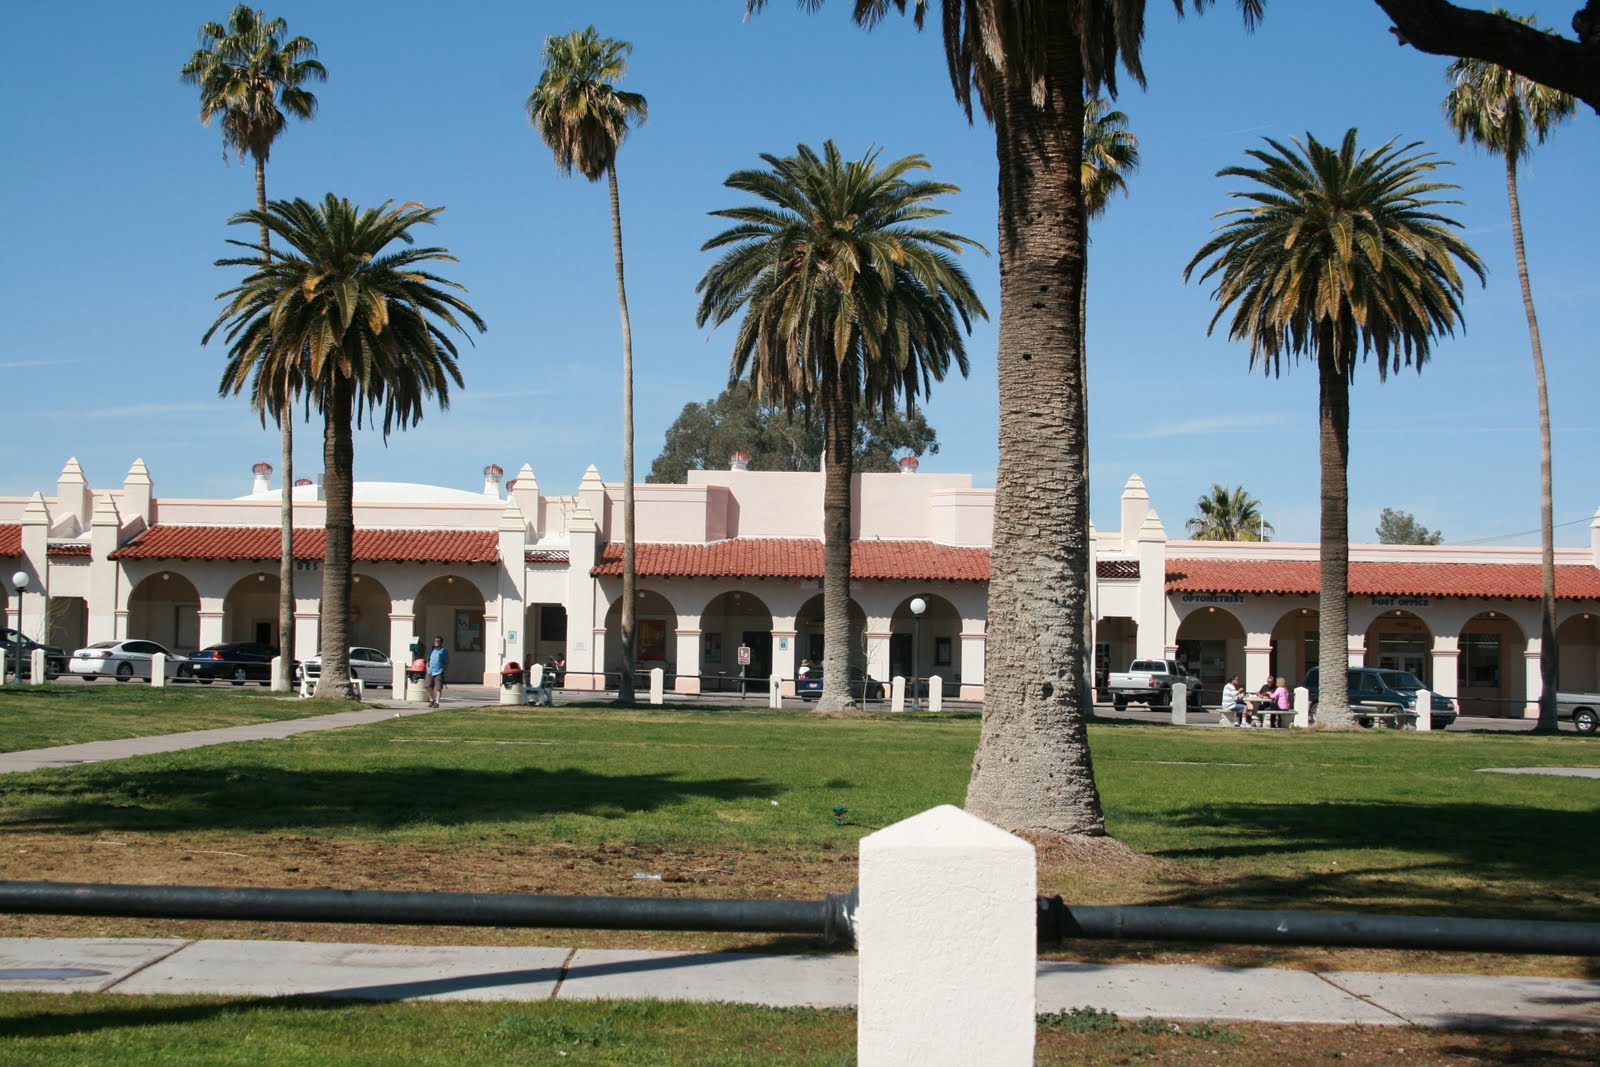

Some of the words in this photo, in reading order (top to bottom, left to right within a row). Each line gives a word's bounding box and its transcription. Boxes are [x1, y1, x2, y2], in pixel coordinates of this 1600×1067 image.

[1182, 595, 1244, 603] OPTOMETRIST
[1371, 598, 1394, 606] POST
[1398, 599, 1430, 607] OFFICE
